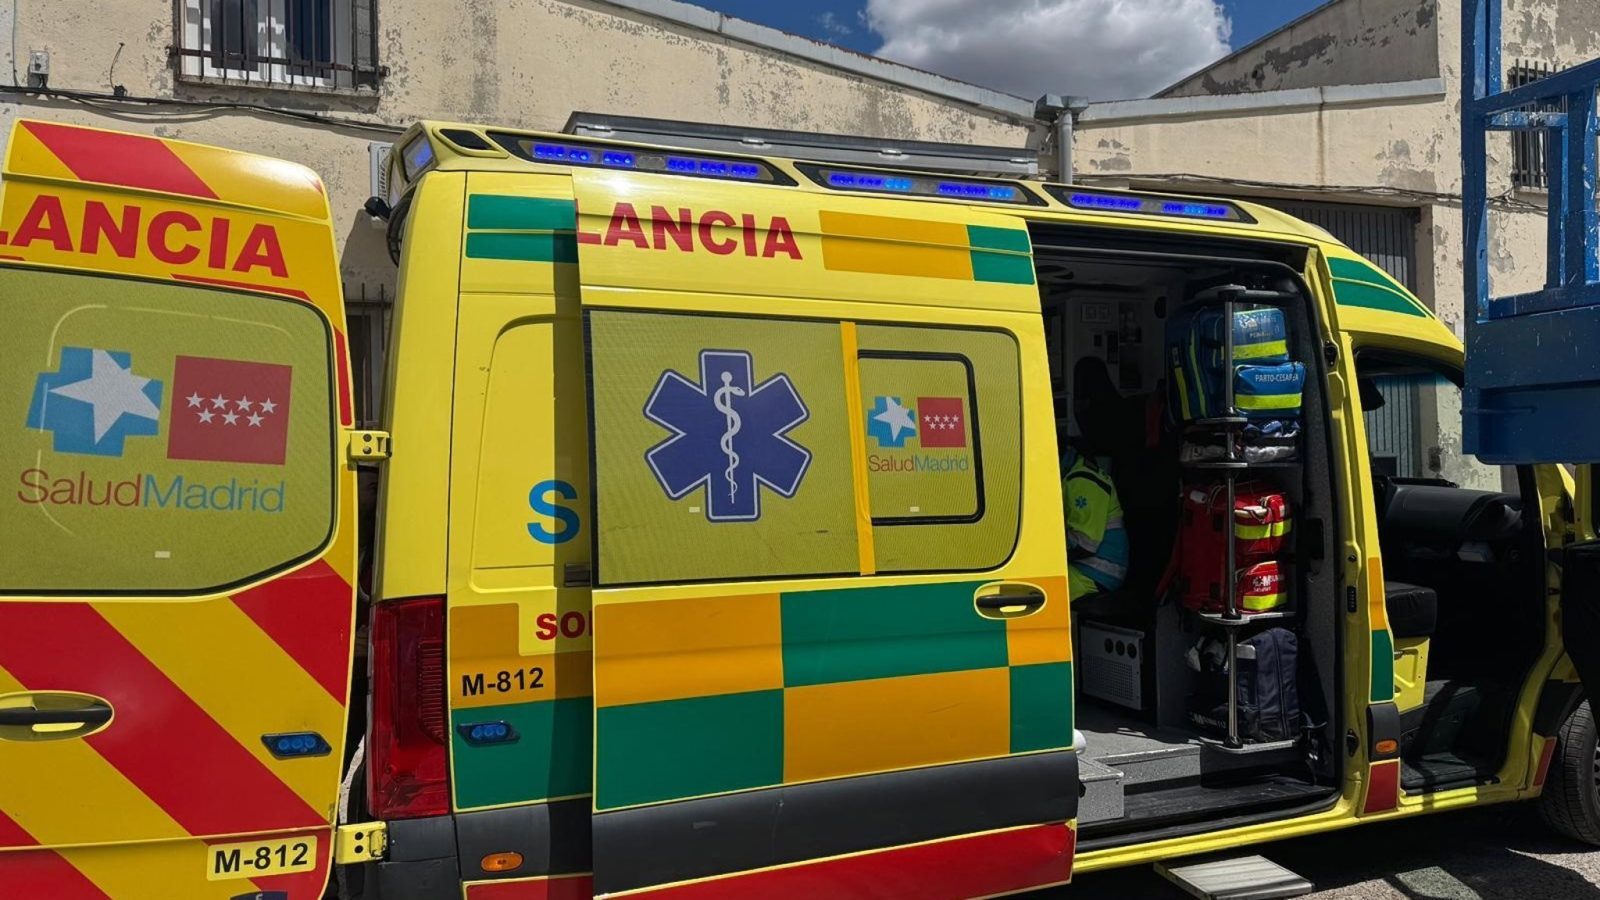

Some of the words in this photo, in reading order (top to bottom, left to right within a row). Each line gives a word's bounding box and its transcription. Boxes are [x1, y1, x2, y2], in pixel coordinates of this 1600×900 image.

[868, 454, 969, 473] SaludMadrid
[17, 468, 285, 512] SaludMadrid
[536, 609, 593, 641] SO
[461, 667, 544, 697] M-812
[213, 843, 309, 874] M-812
